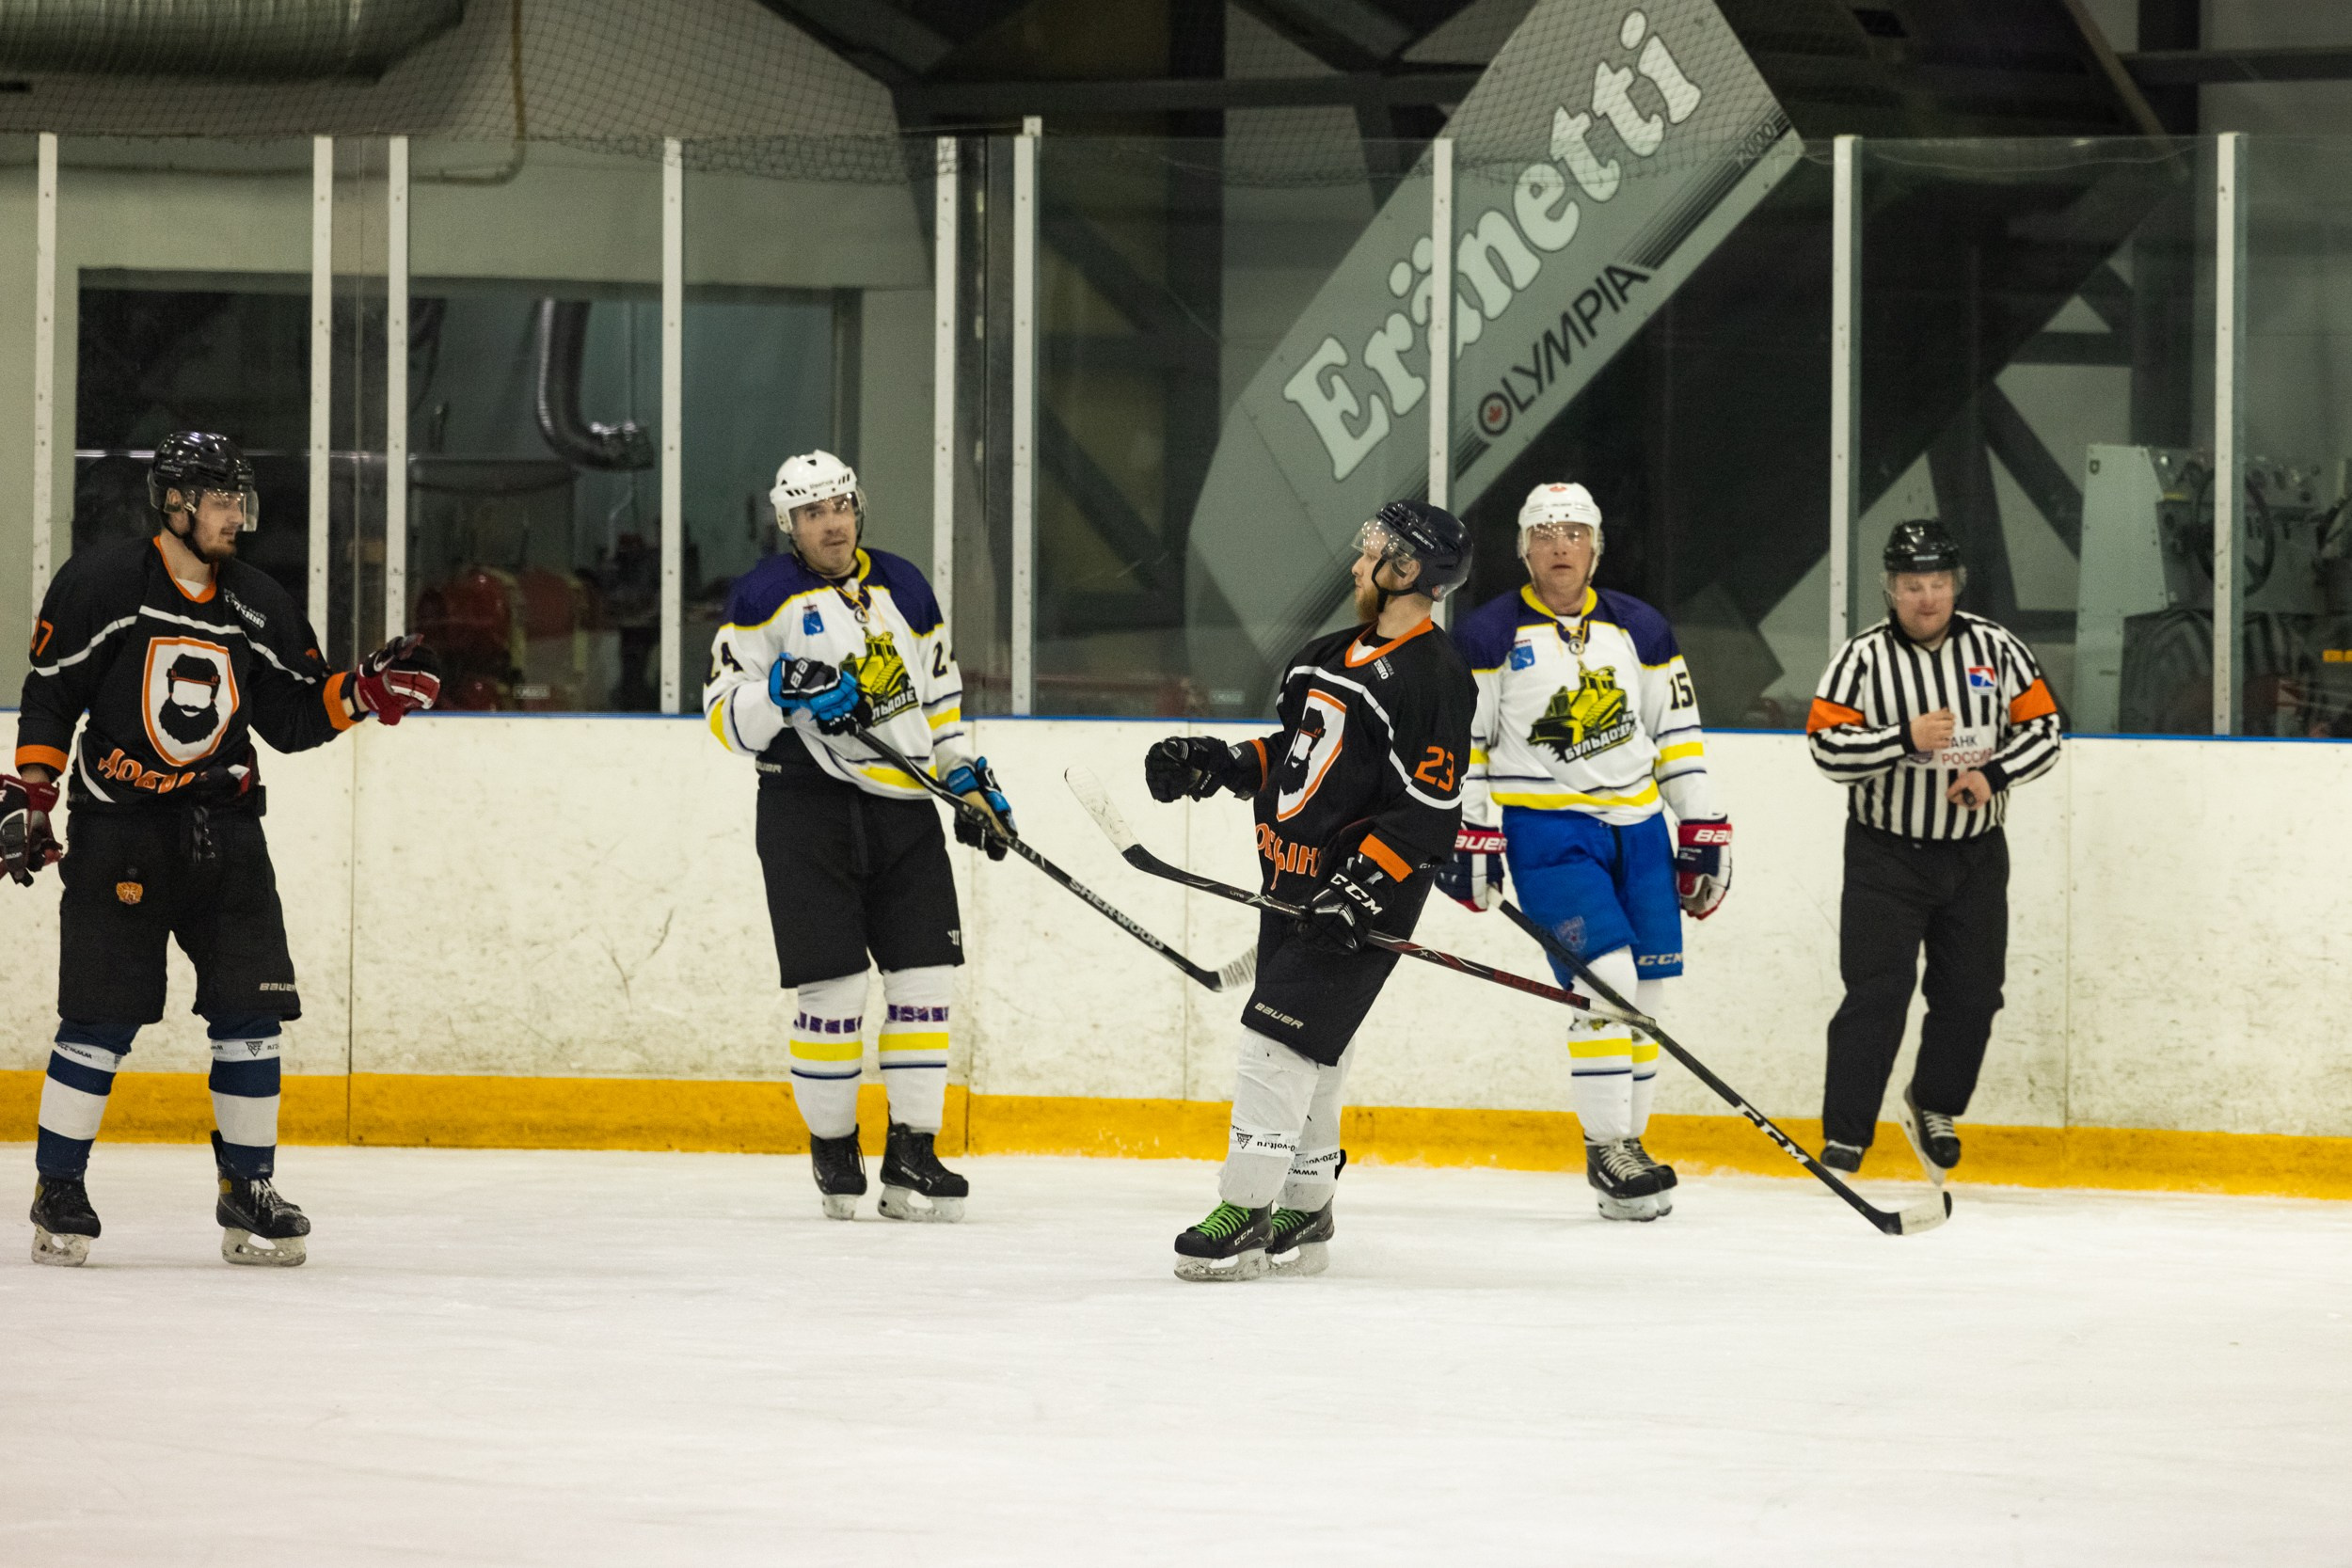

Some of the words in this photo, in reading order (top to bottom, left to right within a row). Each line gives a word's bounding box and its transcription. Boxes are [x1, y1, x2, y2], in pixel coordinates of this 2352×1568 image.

[1478, 264, 1651, 437] OLYMPIA
[1669, 671, 1694, 710] 15
[1414, 745, 1454, 792] 23
[1330, 872, 1383, 915] CCM
[1255, 1002, 1304, 1029] BAUER
[1736, 1101, 1810, 1163] CCM
[1233, 1227, 1254, 1246] CCM
[1295, 1222, 1318, 1241] CCM
